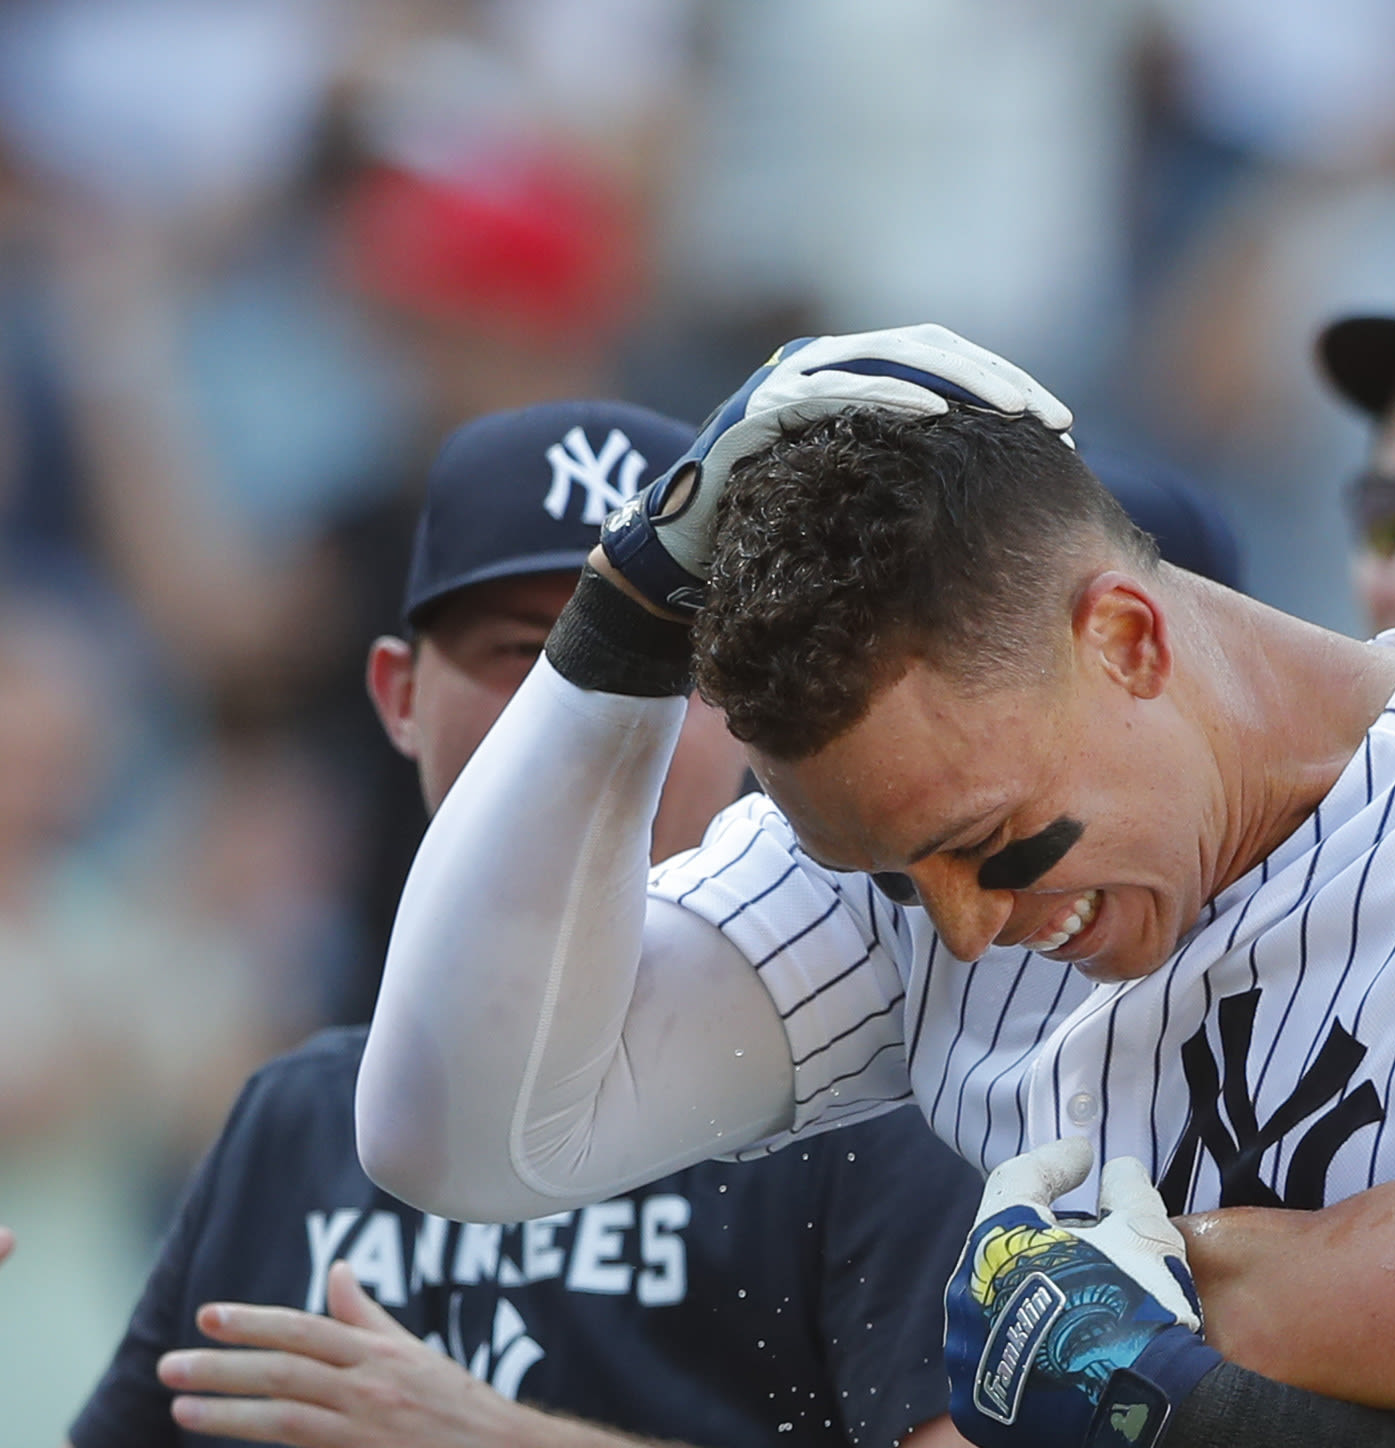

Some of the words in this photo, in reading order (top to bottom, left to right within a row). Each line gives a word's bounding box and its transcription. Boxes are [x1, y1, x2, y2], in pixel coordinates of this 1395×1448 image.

[543, 425, 648, 525] NY
[1157, 987, 1386, 1211] NY
[305, 1194, 692, 1315] YANKEES
